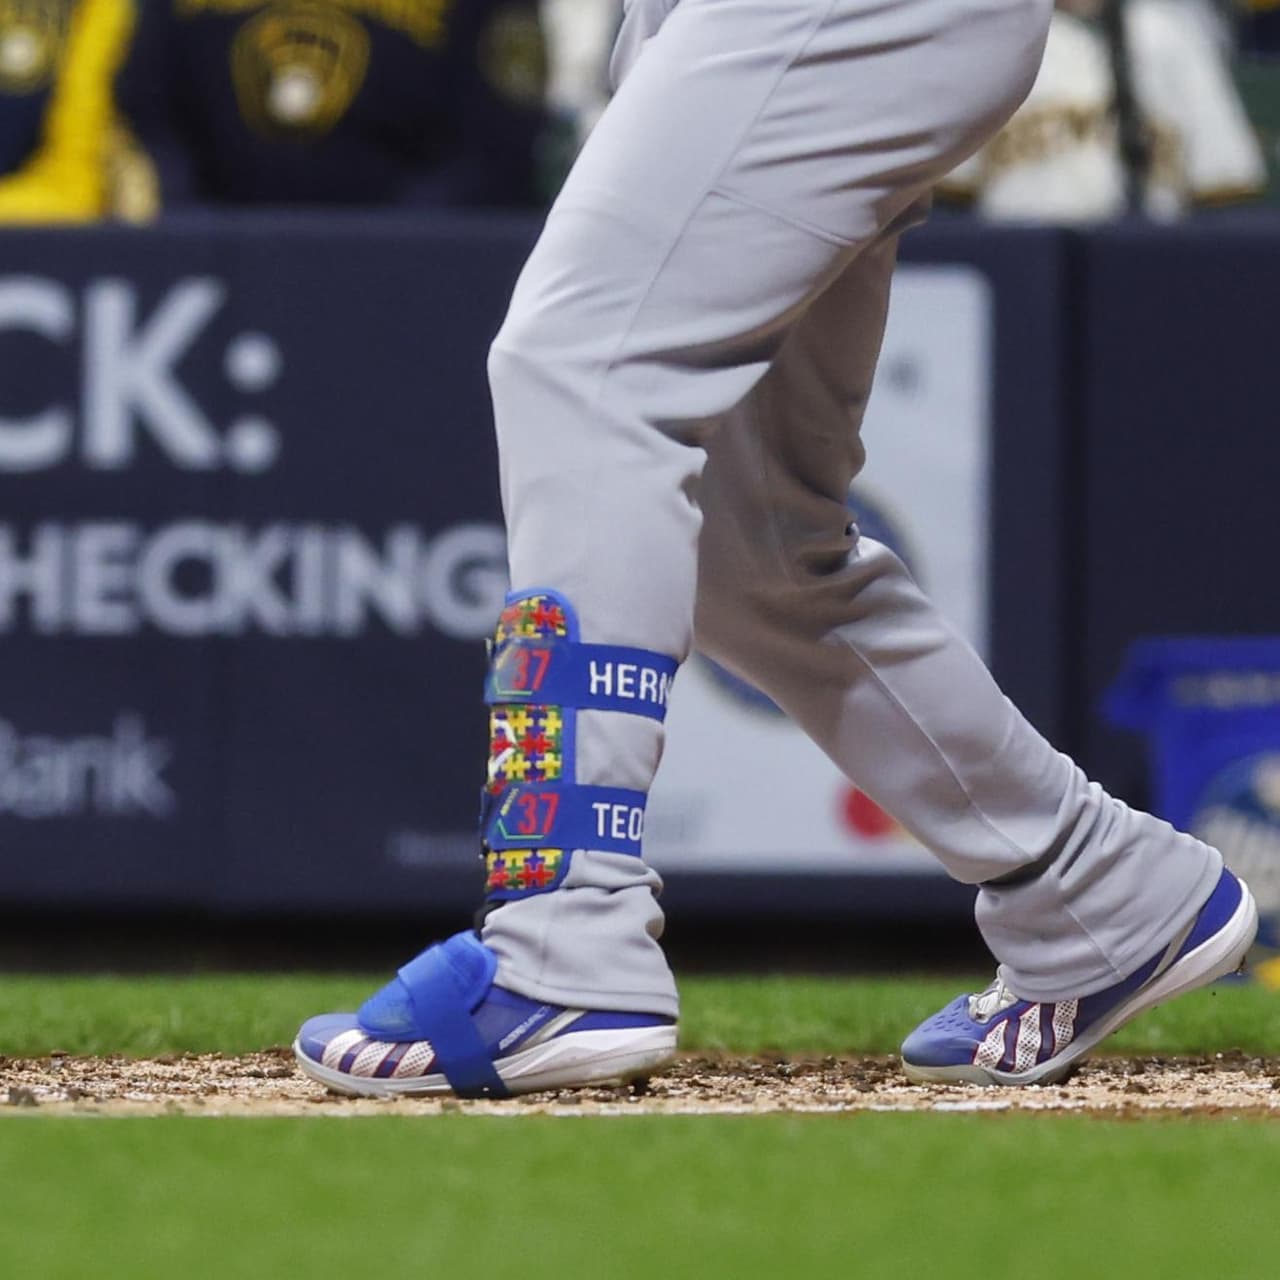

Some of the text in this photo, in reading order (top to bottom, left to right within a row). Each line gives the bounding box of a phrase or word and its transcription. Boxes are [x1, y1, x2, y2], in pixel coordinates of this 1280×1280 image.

[513, 648, 552, 691] 37
[517, 792, 561, 836] 37
[592, 802, 644, 842] TEO
